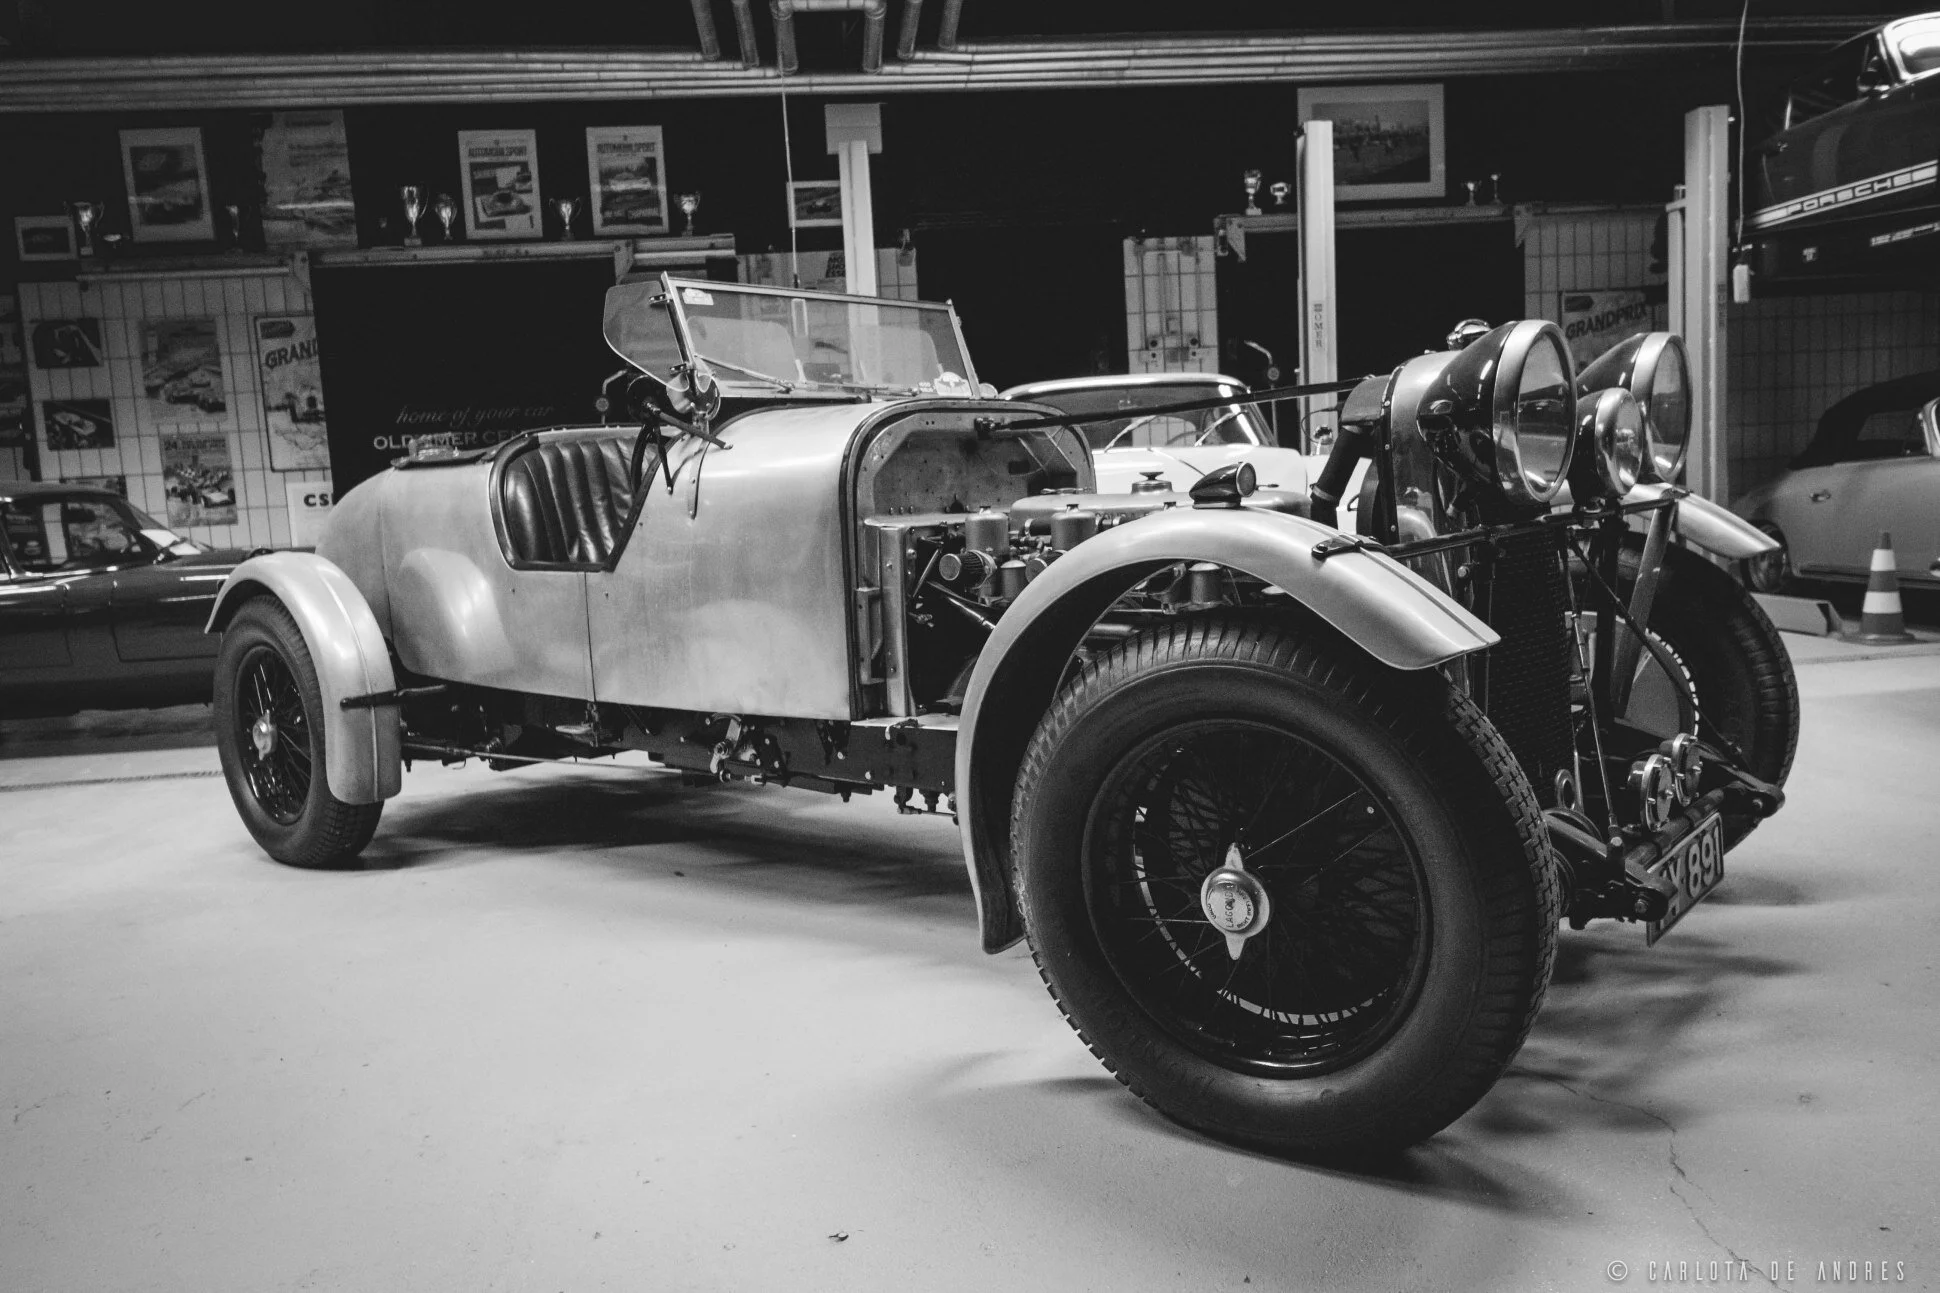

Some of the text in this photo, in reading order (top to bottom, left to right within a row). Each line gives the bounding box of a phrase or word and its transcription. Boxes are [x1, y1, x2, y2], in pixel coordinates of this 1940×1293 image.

[1786, 172, 1912, 216] PORSCHE
[373, 431, 477, 450] OLDMER
[1687, 825, 1722, 898] 891
